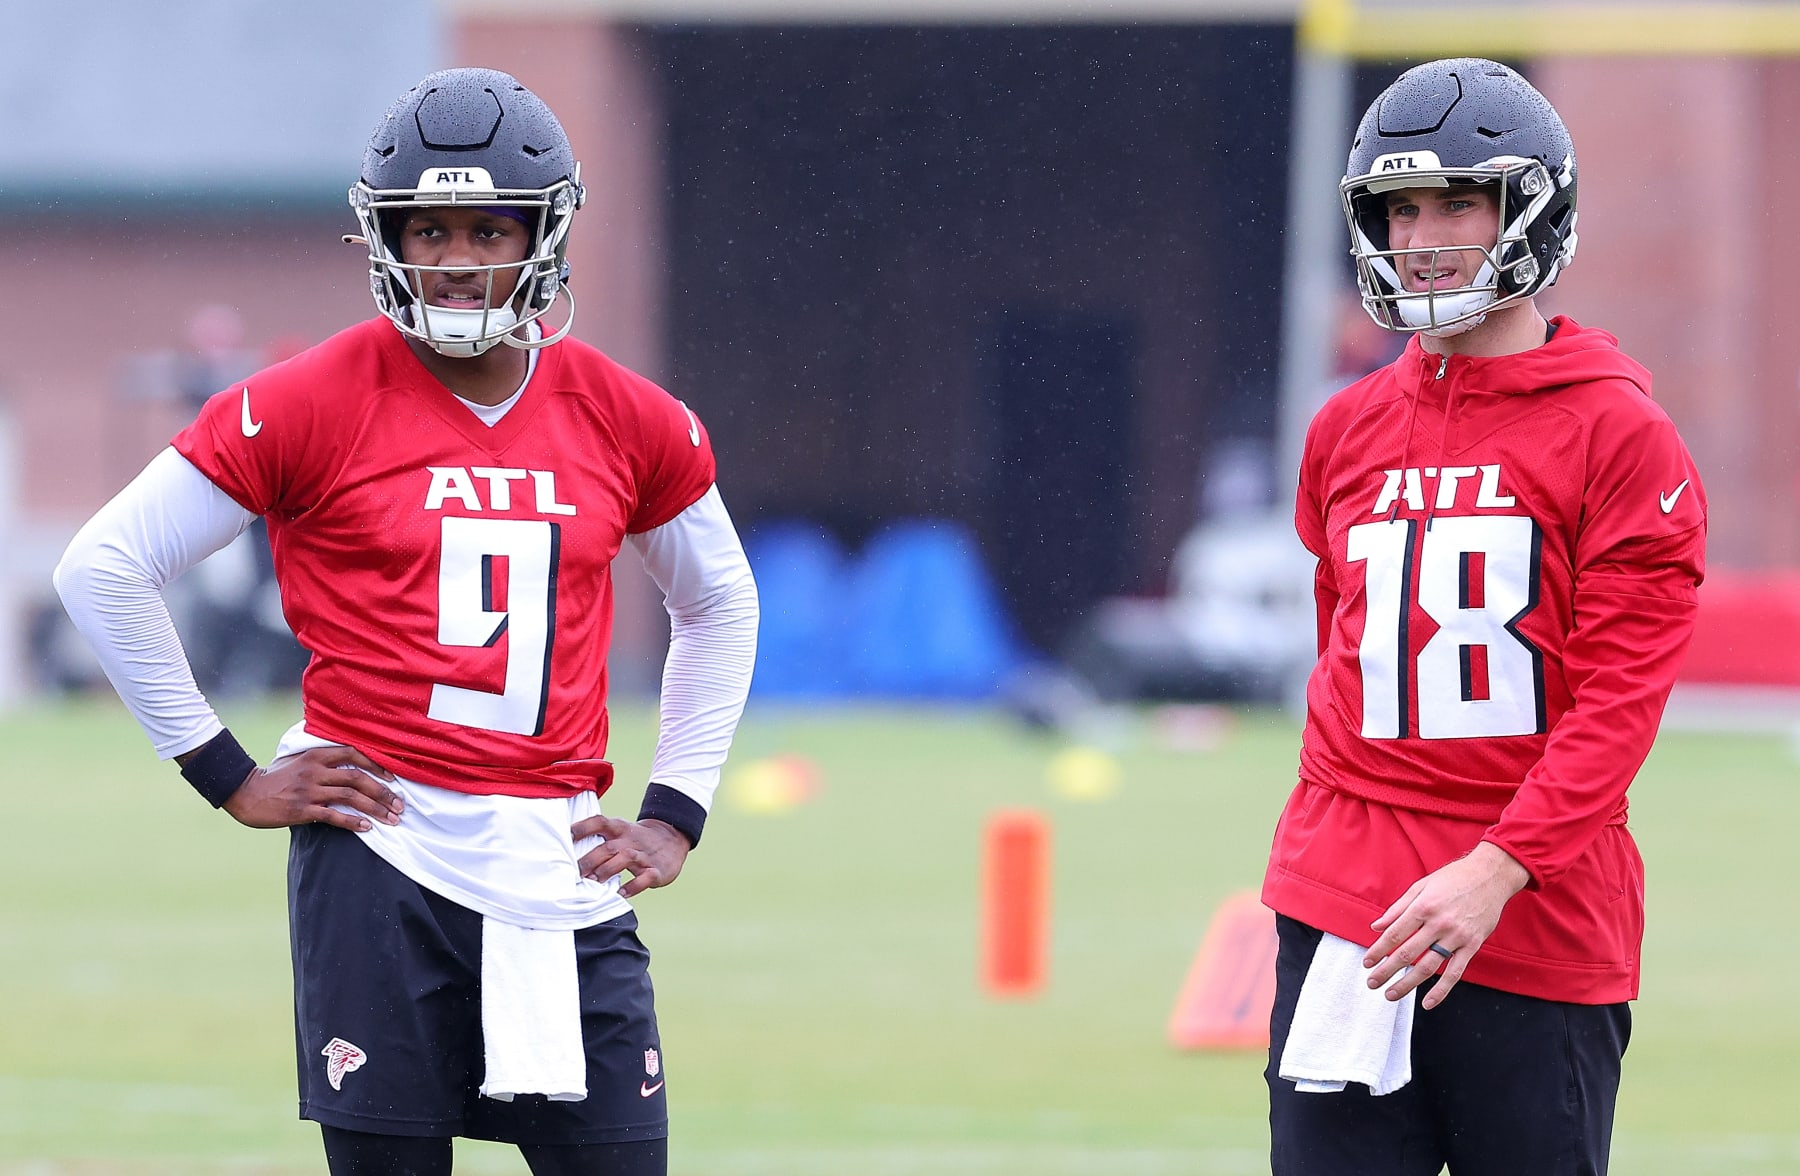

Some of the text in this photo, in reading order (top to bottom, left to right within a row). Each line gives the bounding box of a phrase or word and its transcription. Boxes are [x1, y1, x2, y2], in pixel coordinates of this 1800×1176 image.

[437, 172, 474, 183] ATL
[1382, 157, 1417, 171] ATL
[423, 466, 577, 516] ATL
[1371, 463, 1516, 515] ATL
[427, 515, 561, 737] 9
[1346, 514, 1546, 740] 18
